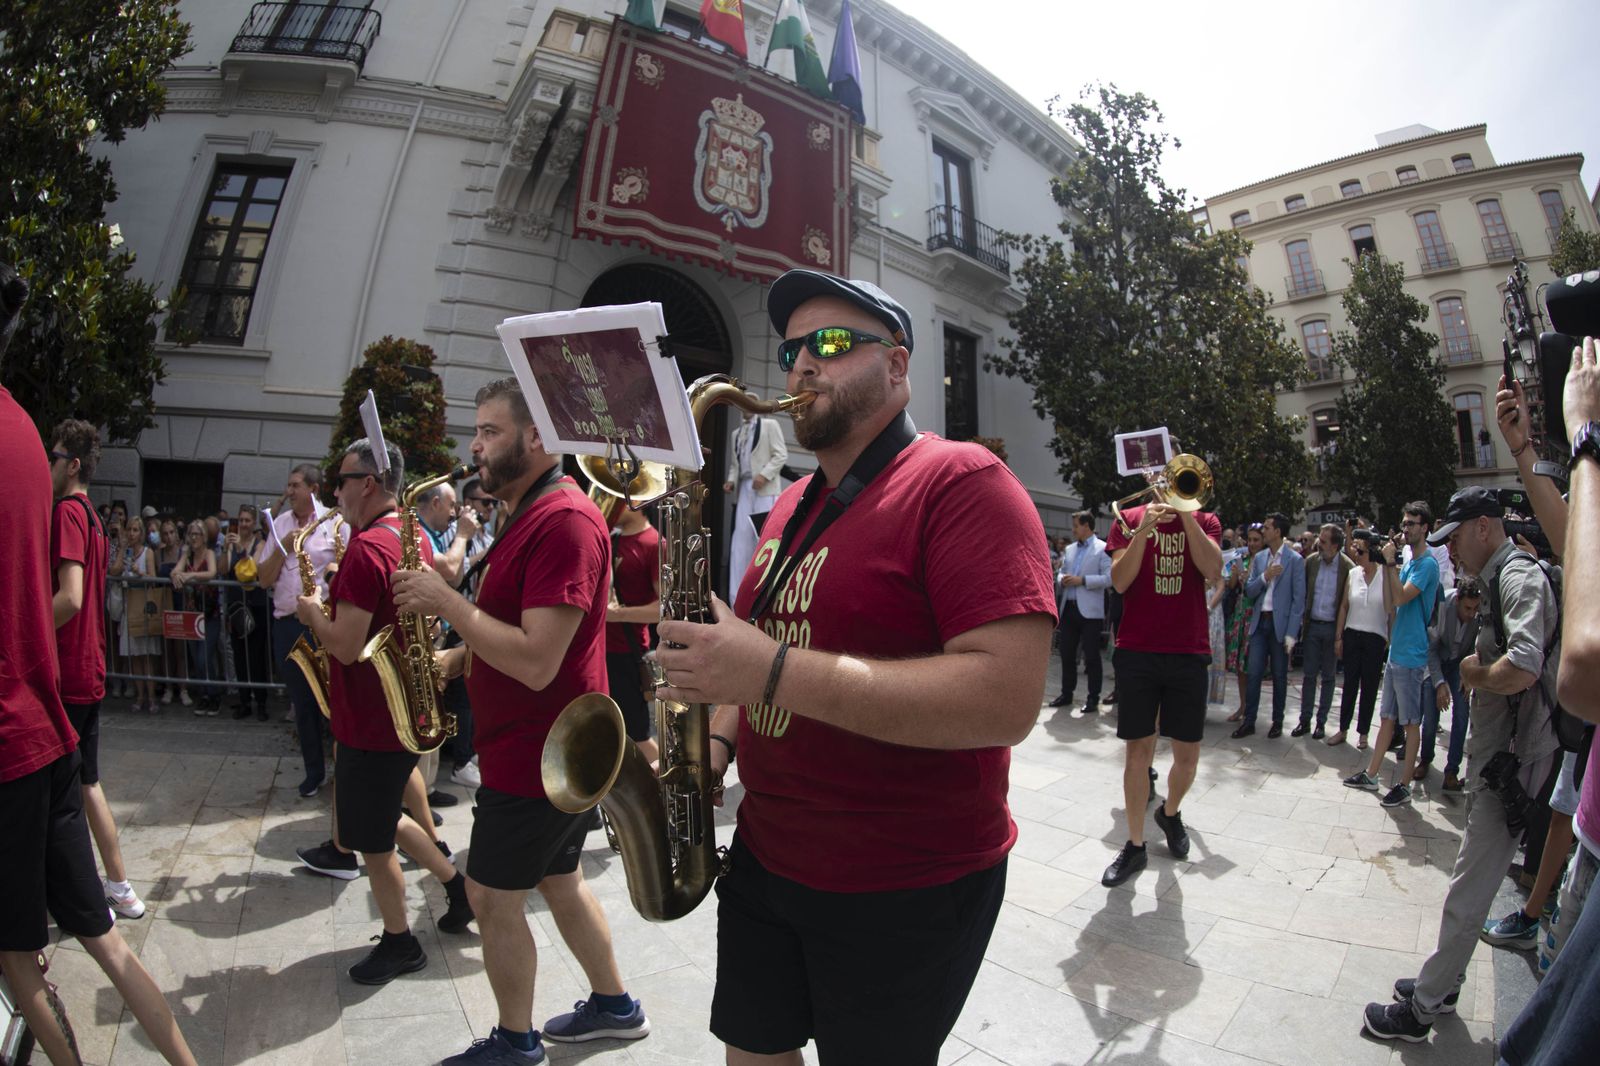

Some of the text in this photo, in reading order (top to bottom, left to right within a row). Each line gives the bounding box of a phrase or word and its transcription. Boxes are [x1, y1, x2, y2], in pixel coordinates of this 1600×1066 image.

[1160, 531, 1185, 555] VASO
[1155, 553, 1184, 575] LARGO
[1155, 575, 1182, 595] BAND
